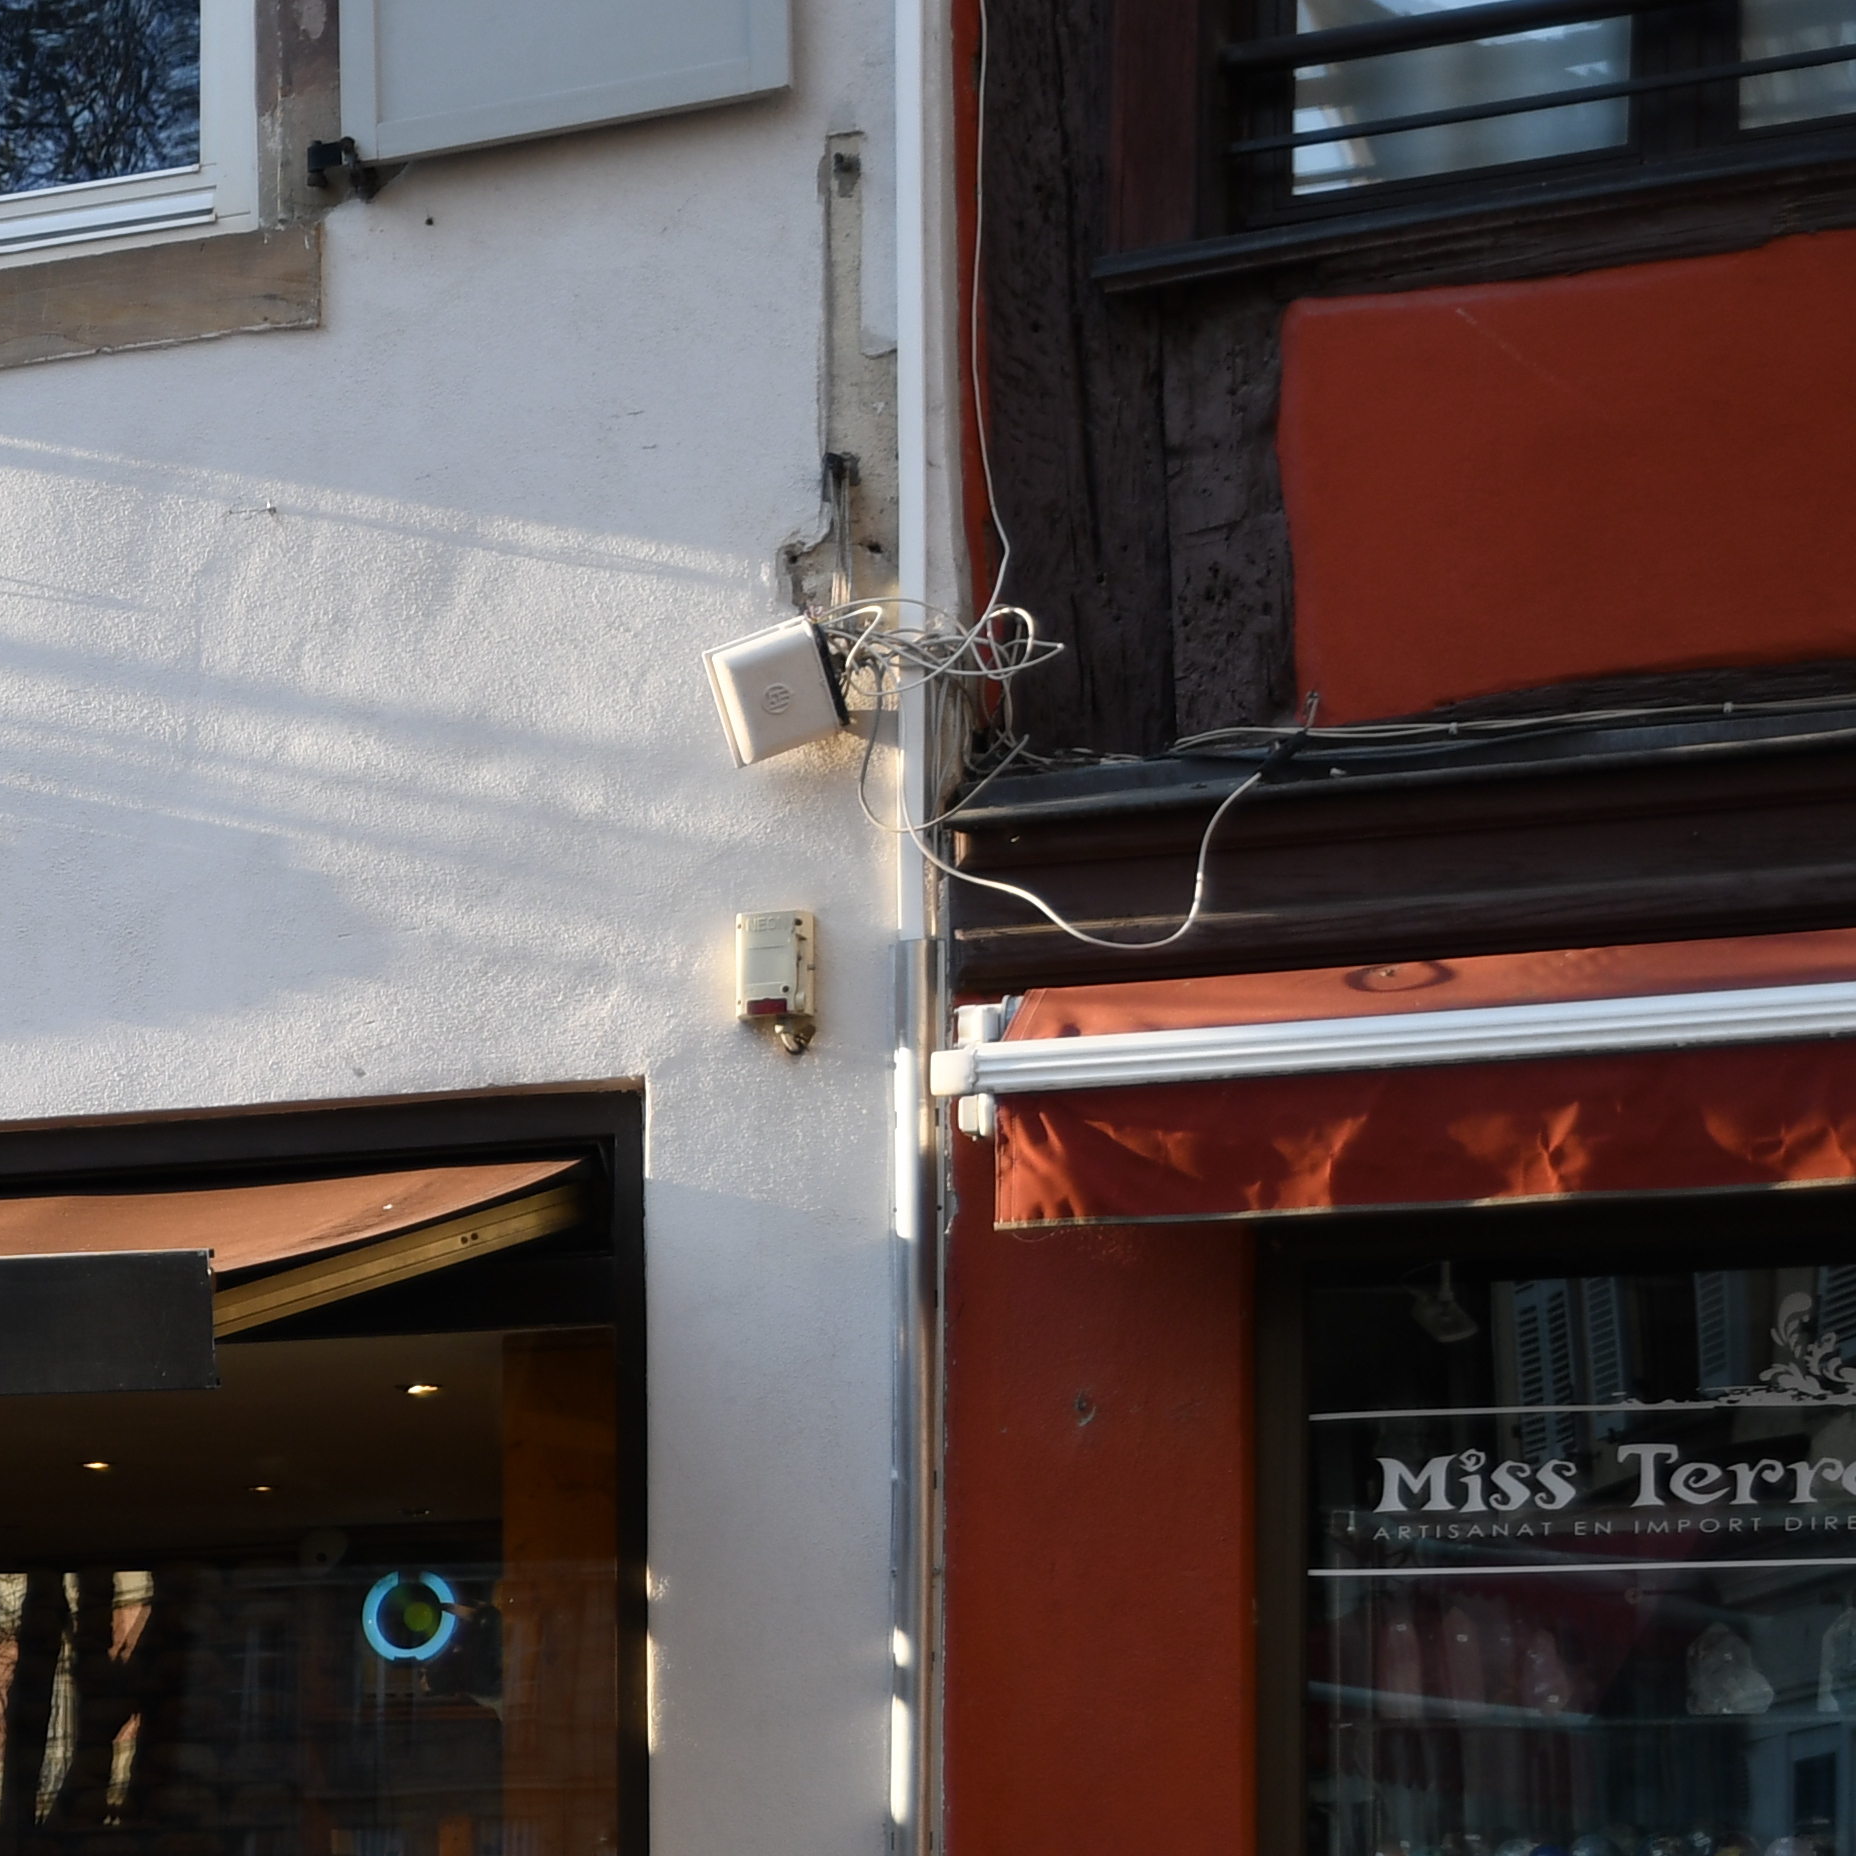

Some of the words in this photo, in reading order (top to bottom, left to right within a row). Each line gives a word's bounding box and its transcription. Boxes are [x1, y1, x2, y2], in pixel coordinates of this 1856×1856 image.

[1372, 1447, 1577, 1514] Miss
[1617, 1443, 1856, 1508] Terr
[1372, 1520, 1553, 1541] ARTISANAT
[1574, 1519, 1612, 1537] EN
[1634, 1516, 1762, 1535] IMPORT
